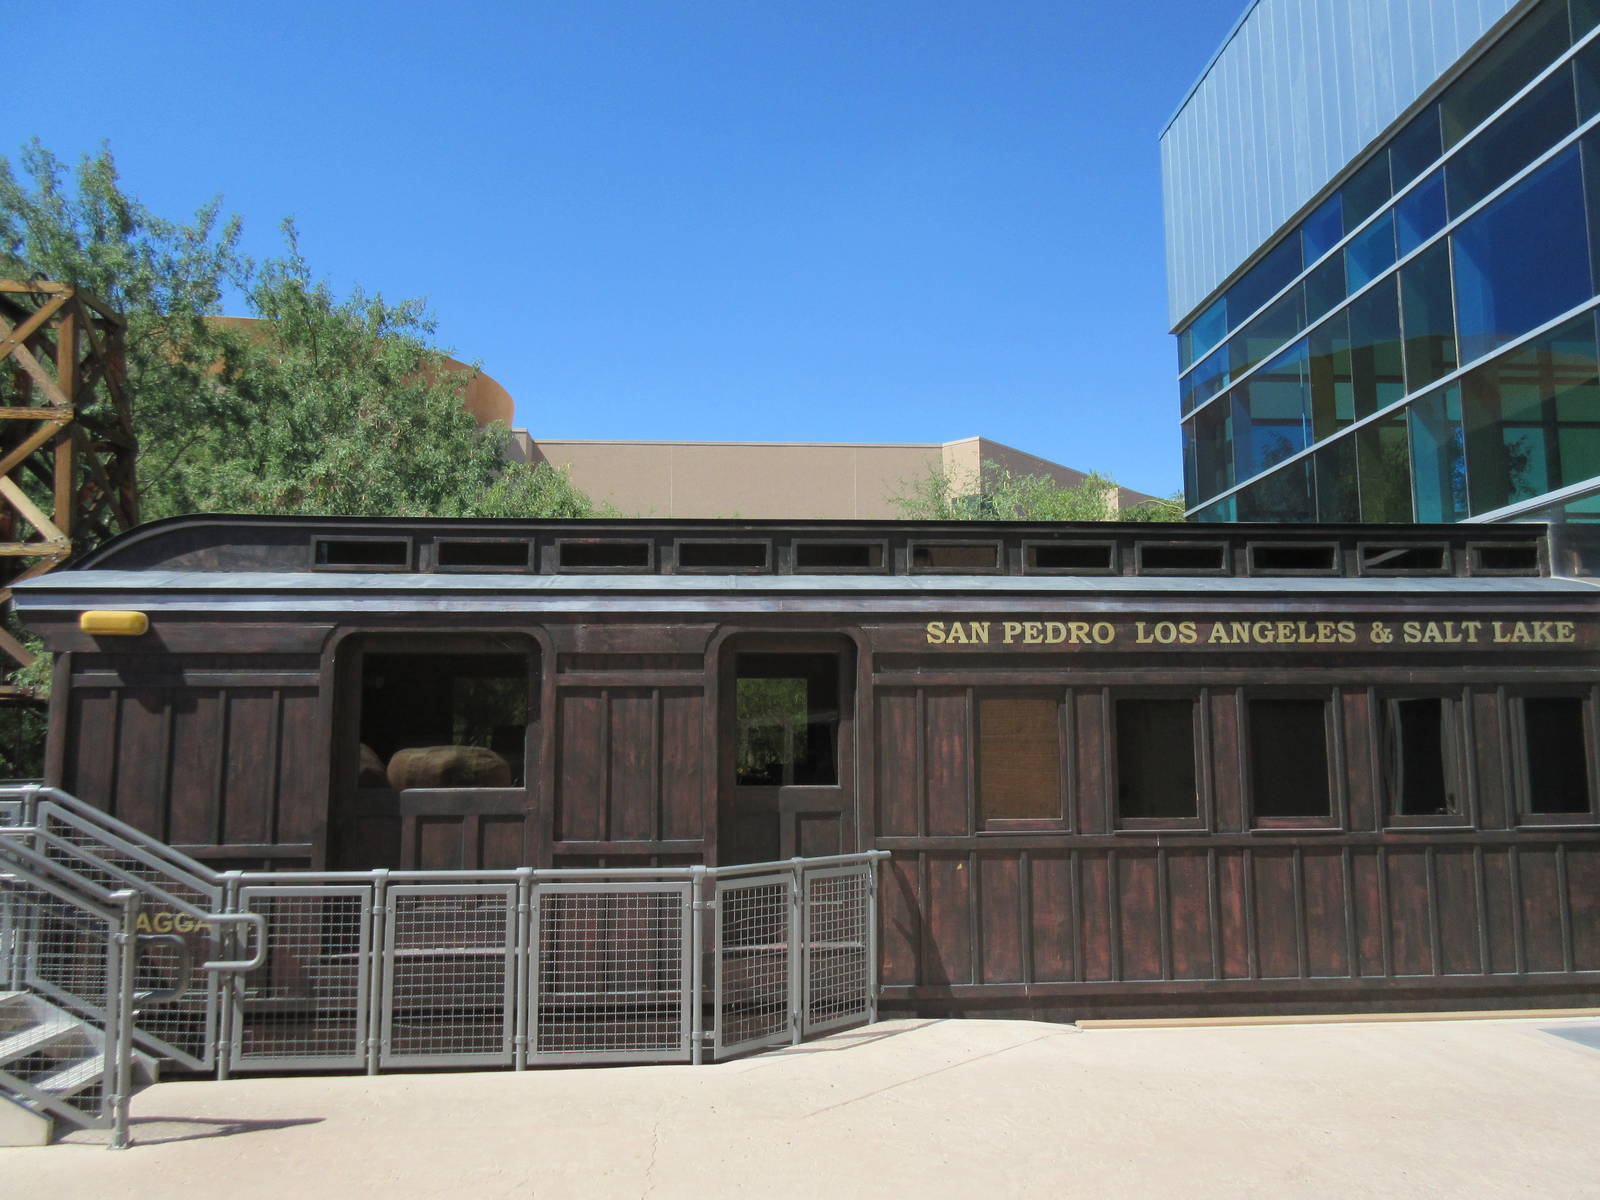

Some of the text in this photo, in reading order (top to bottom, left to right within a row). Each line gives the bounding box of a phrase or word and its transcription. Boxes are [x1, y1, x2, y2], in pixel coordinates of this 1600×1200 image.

[926, 621, 1575, 644] SAN PEDRO LOS ANGELES & SALT LAKE
